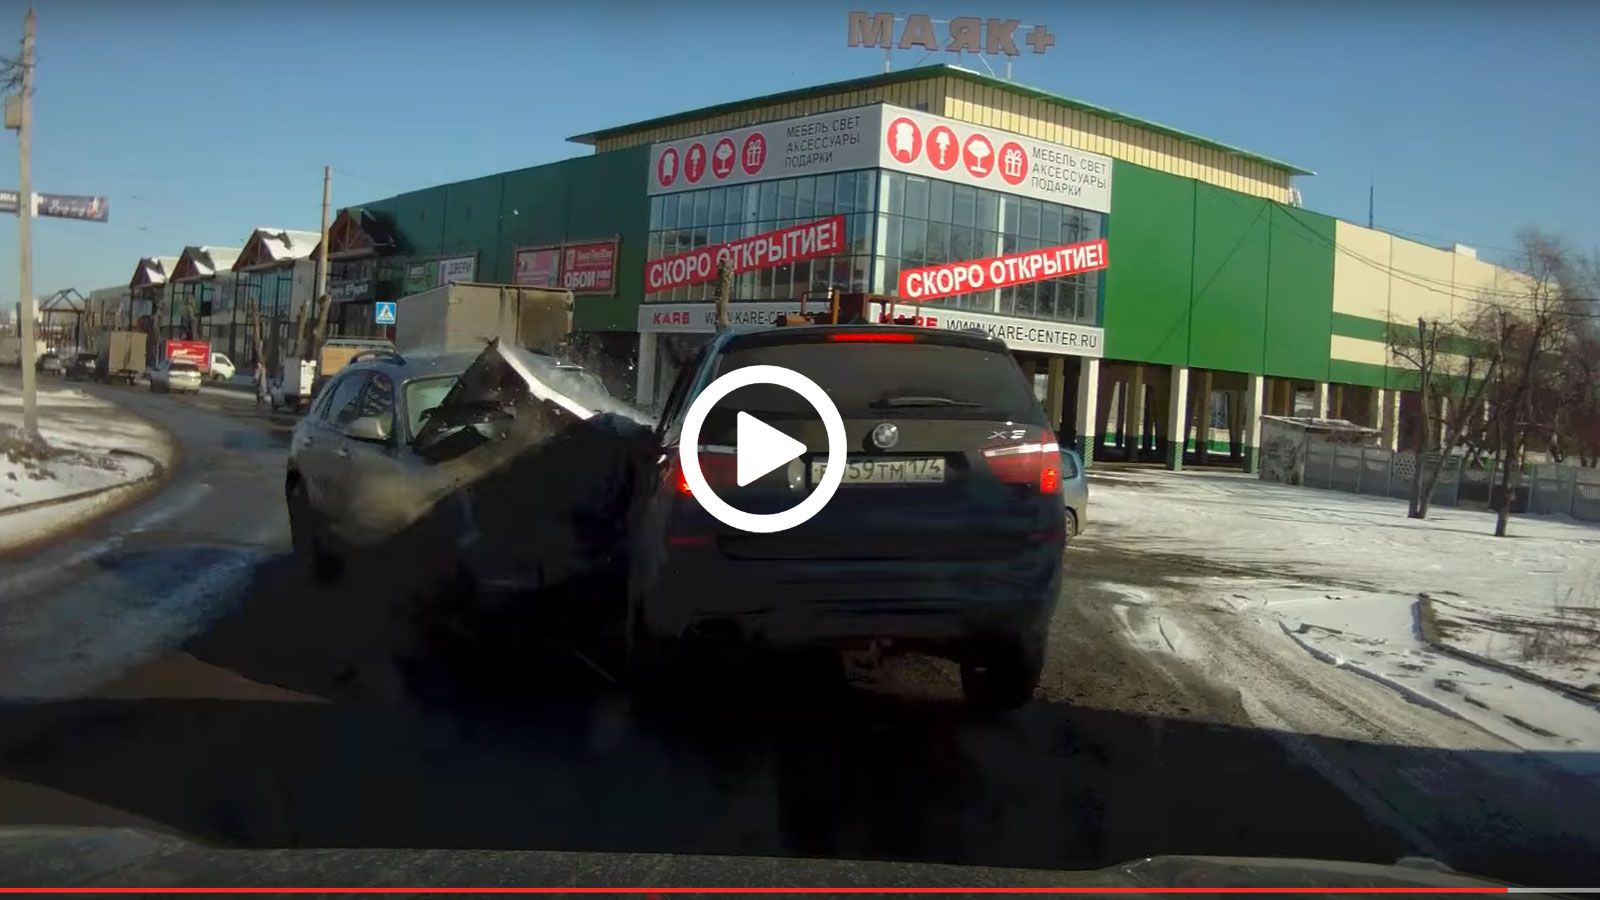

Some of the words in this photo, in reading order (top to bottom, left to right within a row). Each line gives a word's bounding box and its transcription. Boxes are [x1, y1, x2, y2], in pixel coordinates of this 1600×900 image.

[848, 11, 1055, 56] МАЯК+
[786, 122, 829, 138] МЕБЕЛЬ
[833, 116, 861, 132] СВЕТ
[785, 132, 861, 154] АКСЕССУАРЫ
[784, 151, 833, 168] ПОДАРКИ
[1032, 146, 1077, 167] МЕБЕЛЬ
[1080, 158, 1107, 175] СВЕТ
[1031, 176, 1082, 197] ПОДАРКИ
[1032, 163, 1107, 189] АКСЕССУАРЫ
[650, 252, 710, 288] СКОРО
[716, 221, 838, 271] ОТКРЫТИЕ!
[564, 270, 596, 288] ОБОИ
[906, 264, 985, 298] СКОРО
[989, 244, 1104, 284] ОТКРЫТИЕ!
[652, 311, 690, 325] KARE
